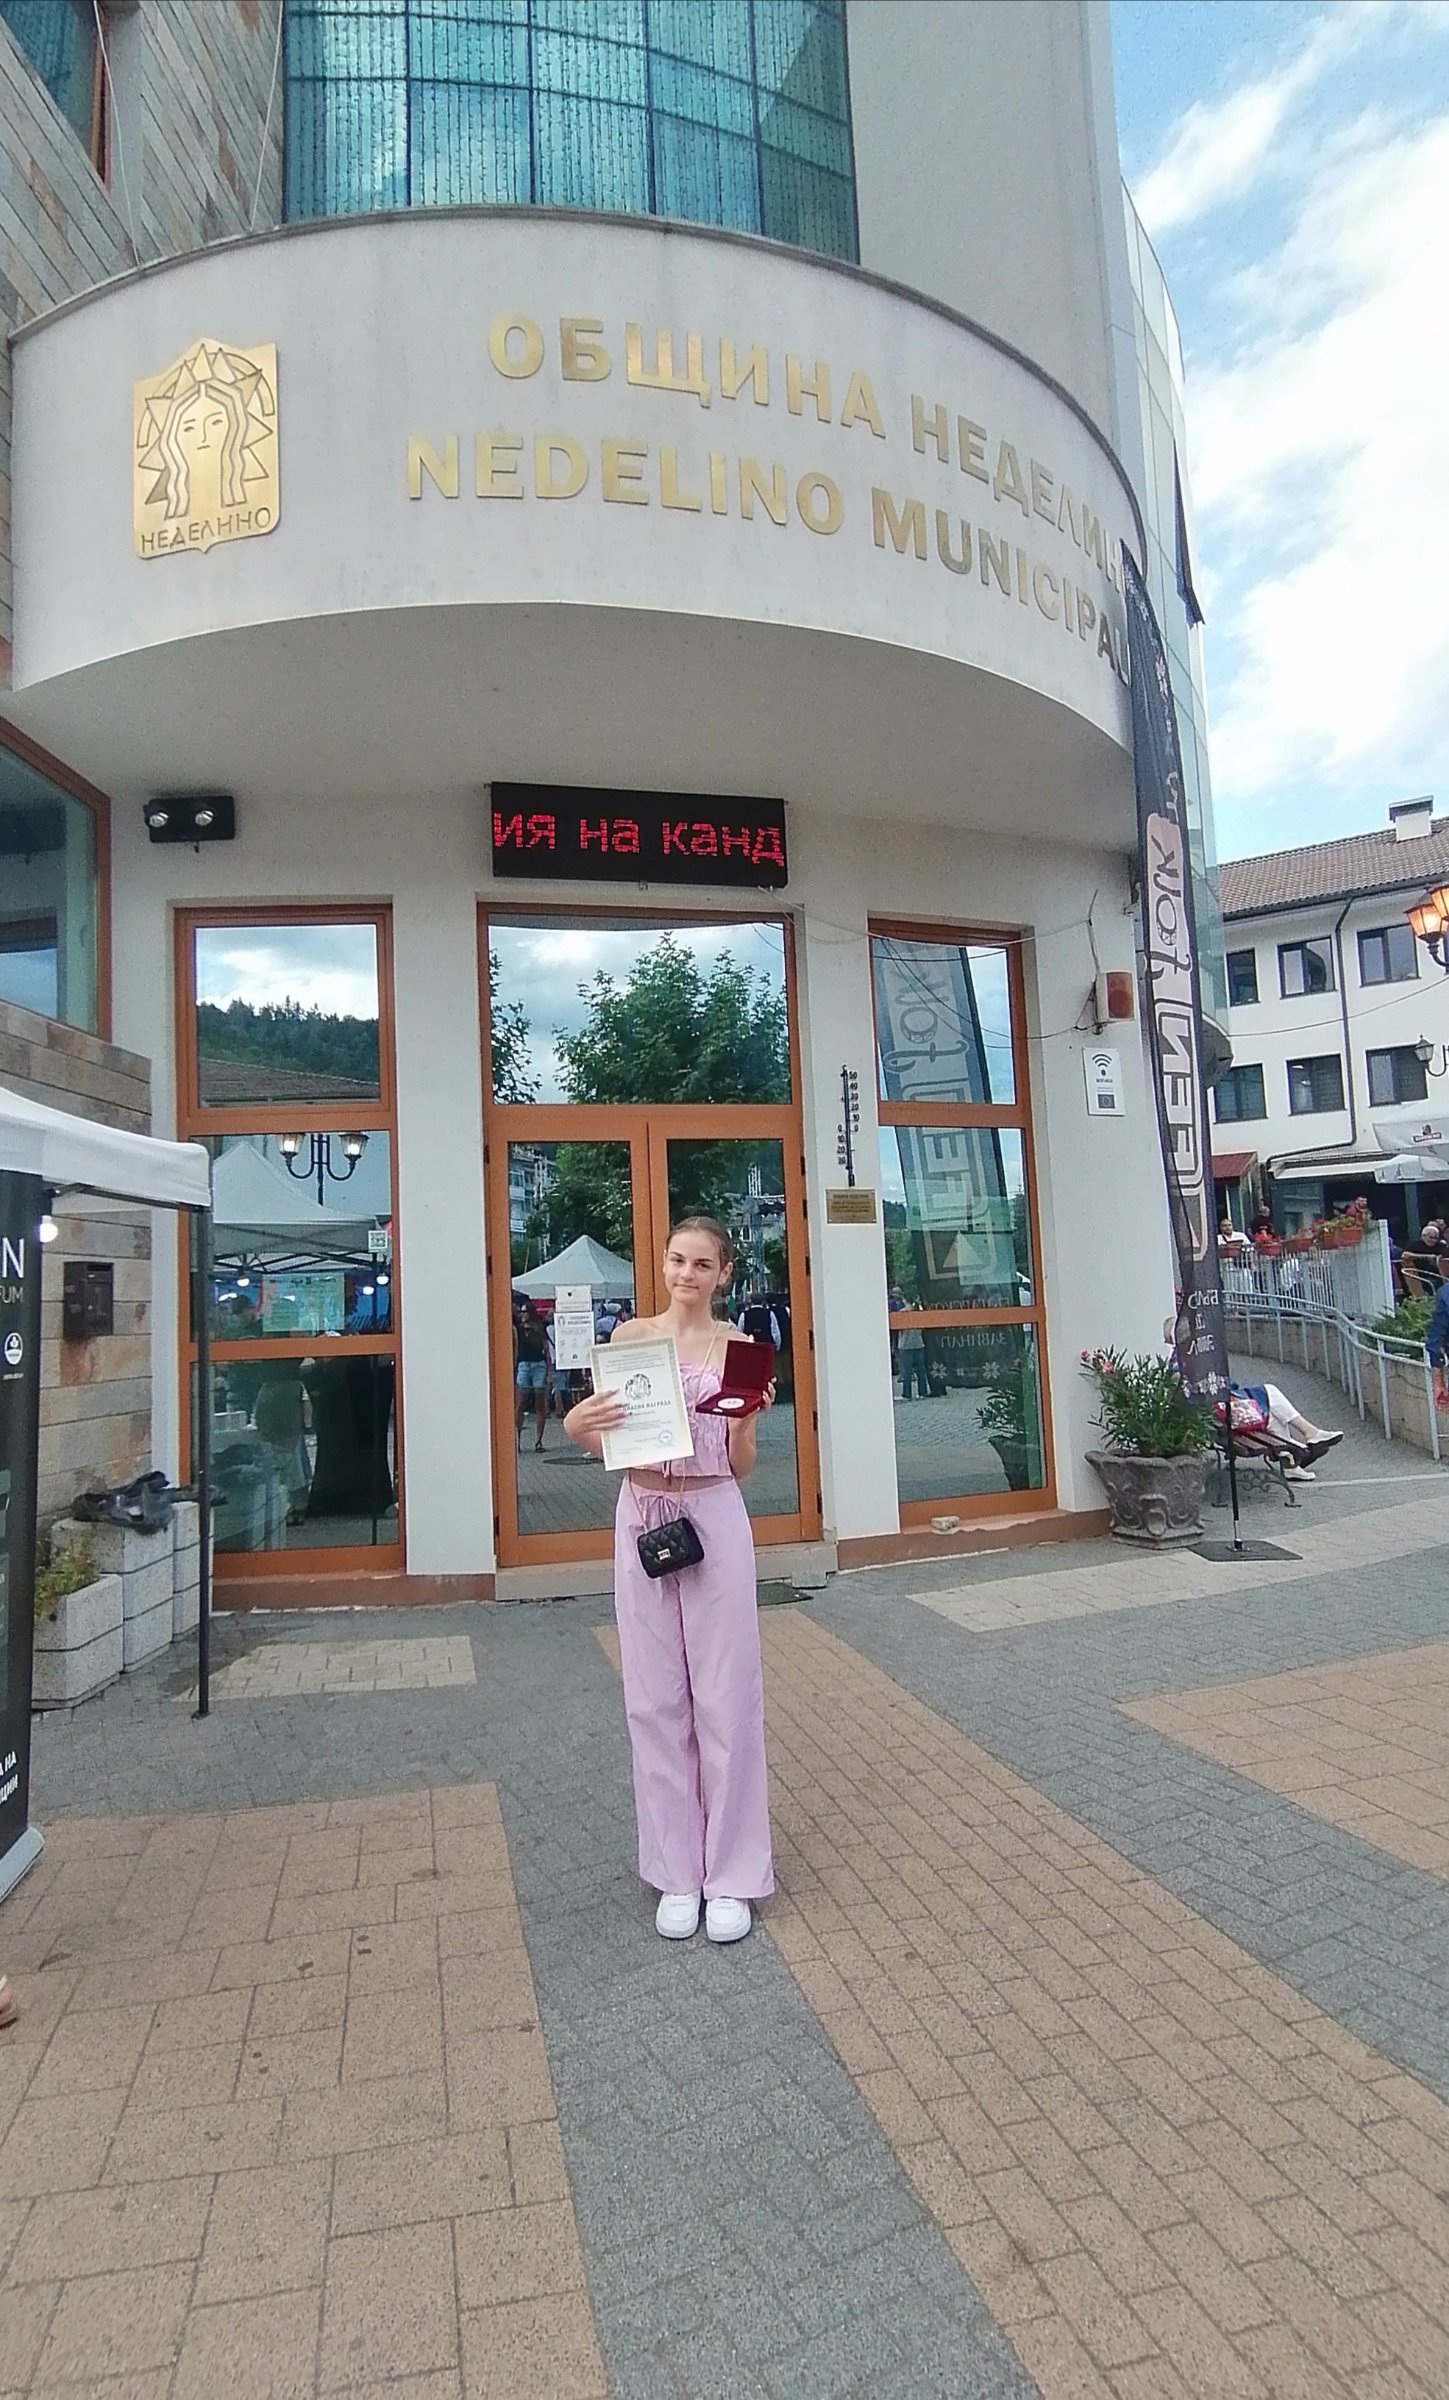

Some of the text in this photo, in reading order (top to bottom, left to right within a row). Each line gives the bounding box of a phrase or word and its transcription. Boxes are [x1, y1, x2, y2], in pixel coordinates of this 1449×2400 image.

[408, 433, 845, 535] NEDELINO
[488, 311, 1122, 594] ОБЩИНА НЕДЕЛИН
[579, 818, 640, 854] на
[661, 821, 785, 867] канд
